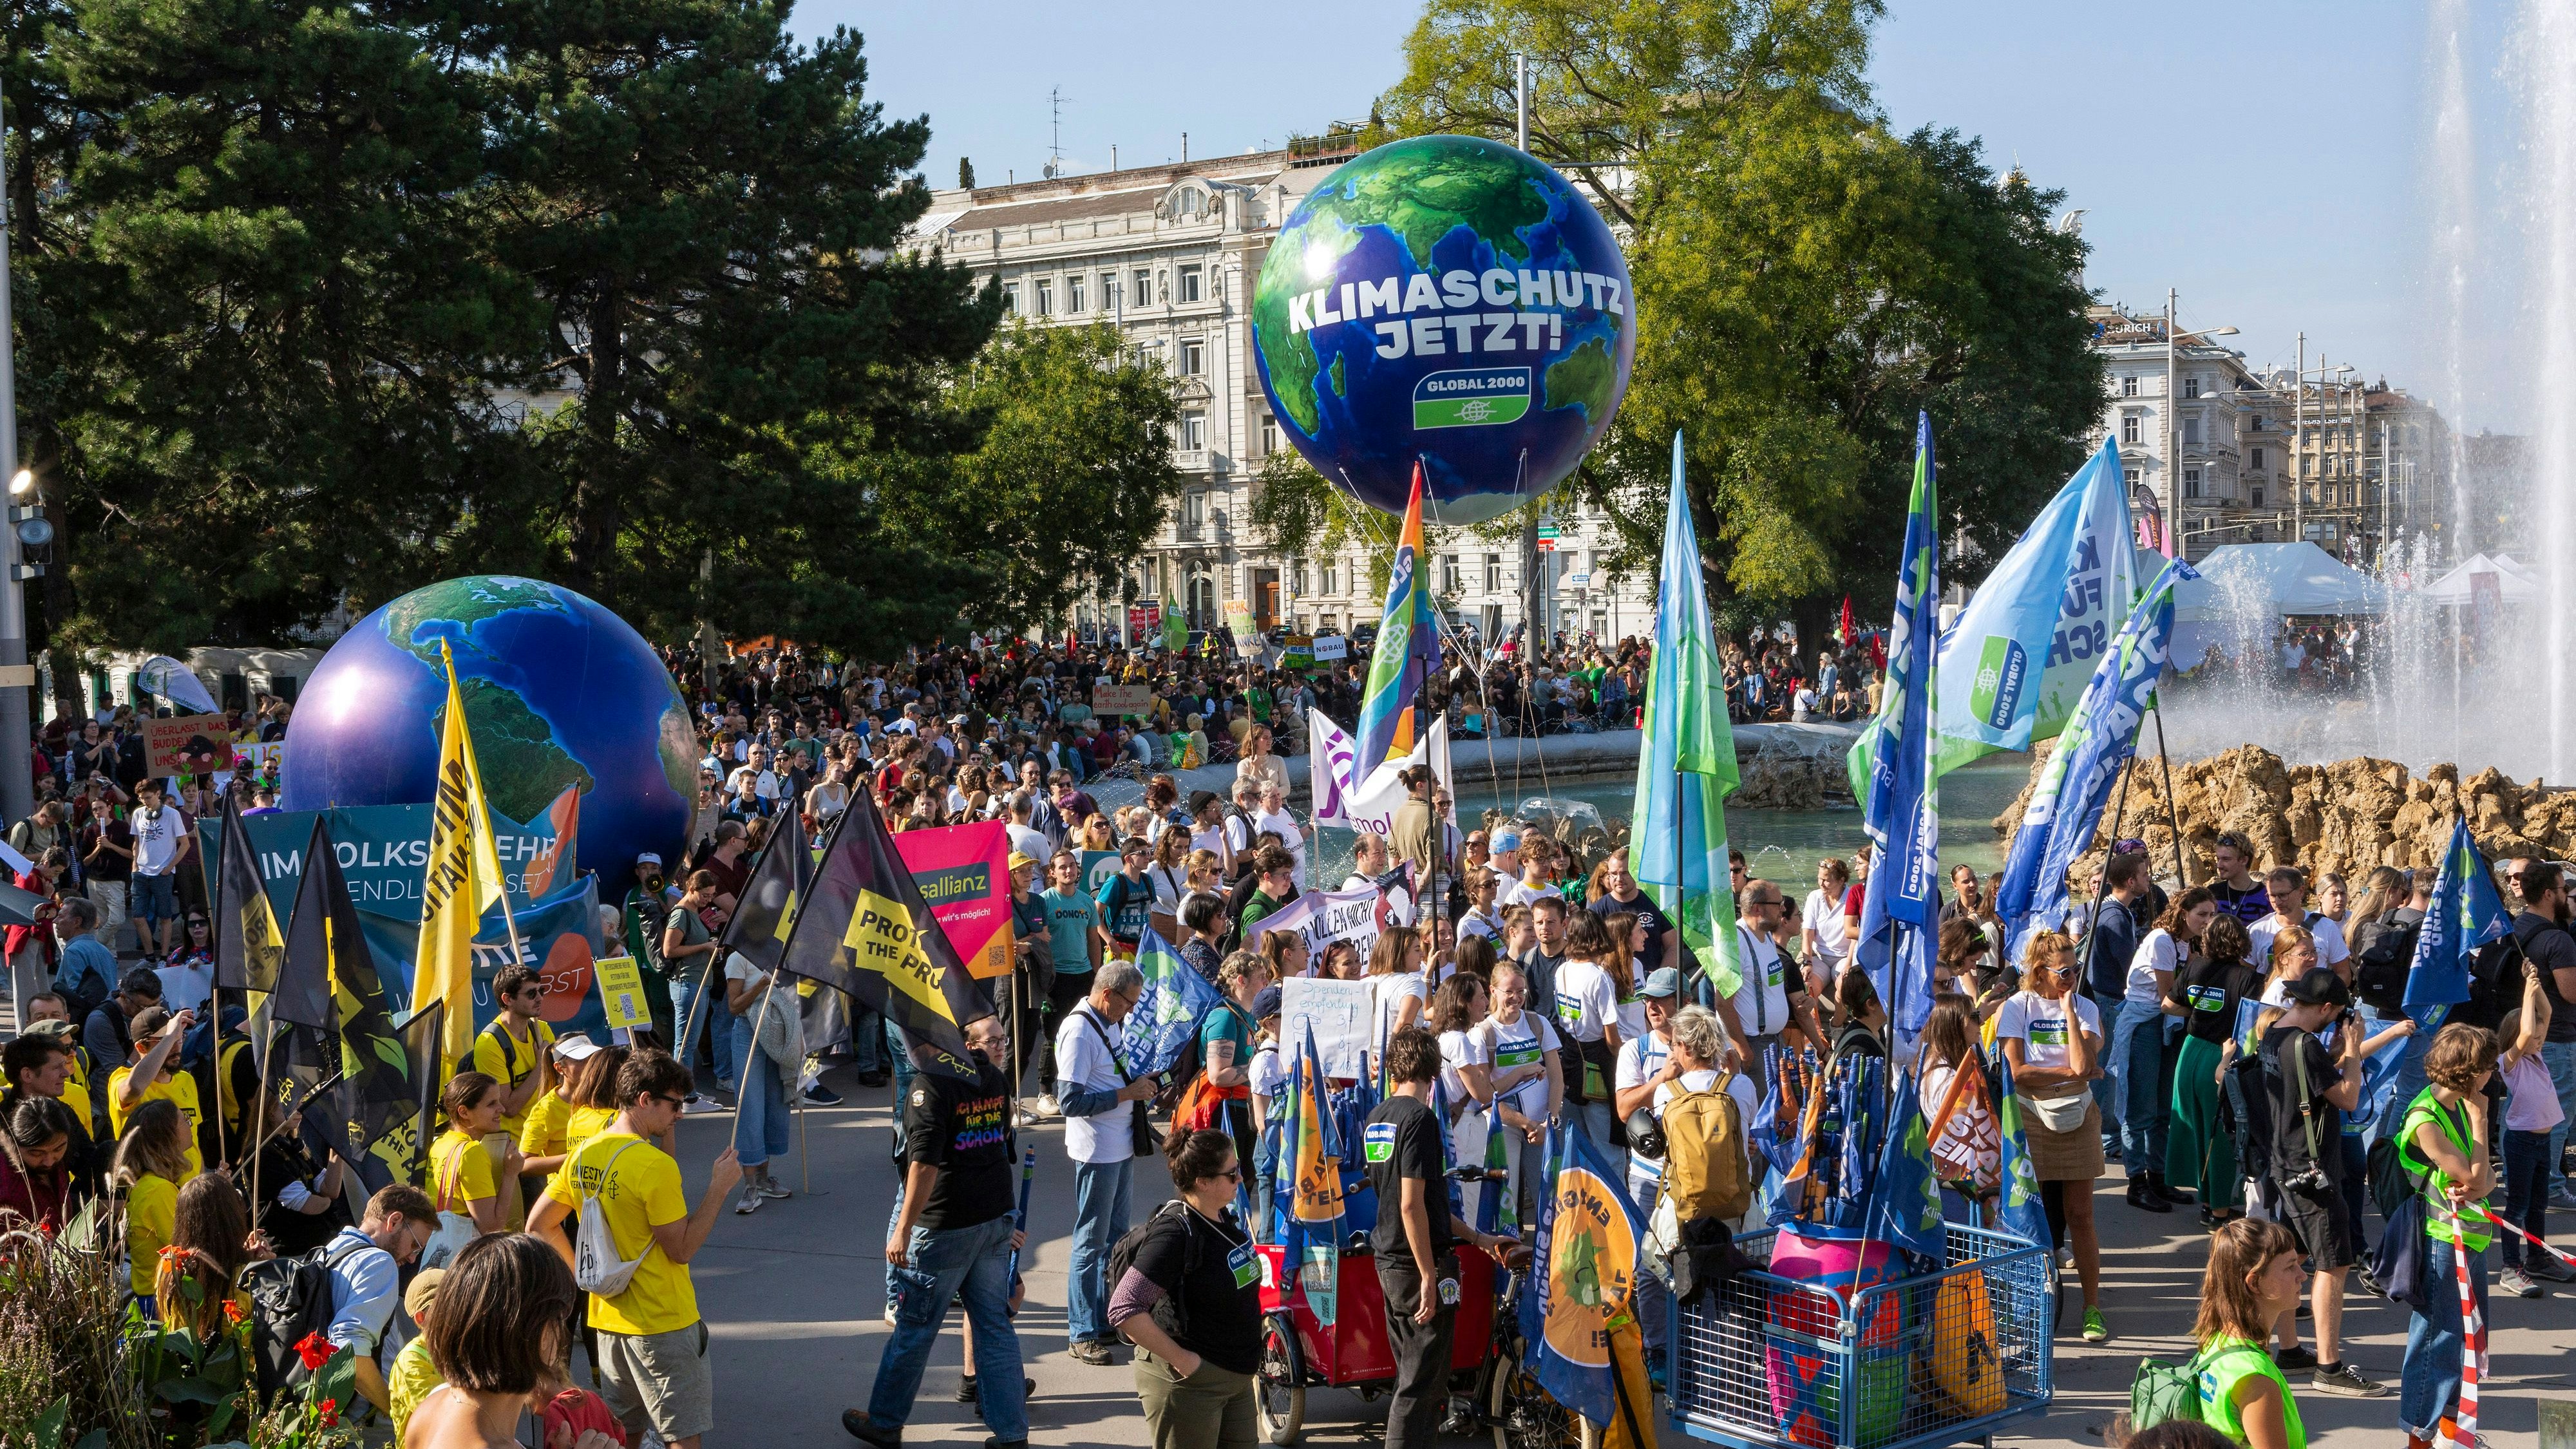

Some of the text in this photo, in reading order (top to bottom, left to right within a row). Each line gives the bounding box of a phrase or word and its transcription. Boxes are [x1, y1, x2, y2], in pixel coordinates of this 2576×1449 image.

[1289, 269, 1624, 334] KLIMASCHUTZ
[1375, 313, 1561, 359] JETZT!
[1427, 376, 1525, 392] GLOBAL 2000
[1224, 600, 1248, 613] MEHR
[1094, 686, 1132, 699] Make the
[1997, 650, 2022, 726] GLOBAL 2000
[1094, 699, 1149, 711] earth cool again
[151, 721, 227, 737] ÜBERLASST DAS
[153, 736, 192, 750] BUDDELN
[155, 753, 180, 767] UNS!
[942, 908, 991, 923] wir's möglich!
[1347, 897, 1377, 928] NICHT
[866, 941, 898, 960] THE
[1302, 979, 1360, 998] Spenden-
[1300, 998, 1359, 1018] empfehlung
[966, 1111, 1001, 1129] FÜR DAS
[571, 1164, 604, 1179] AMNESTY
